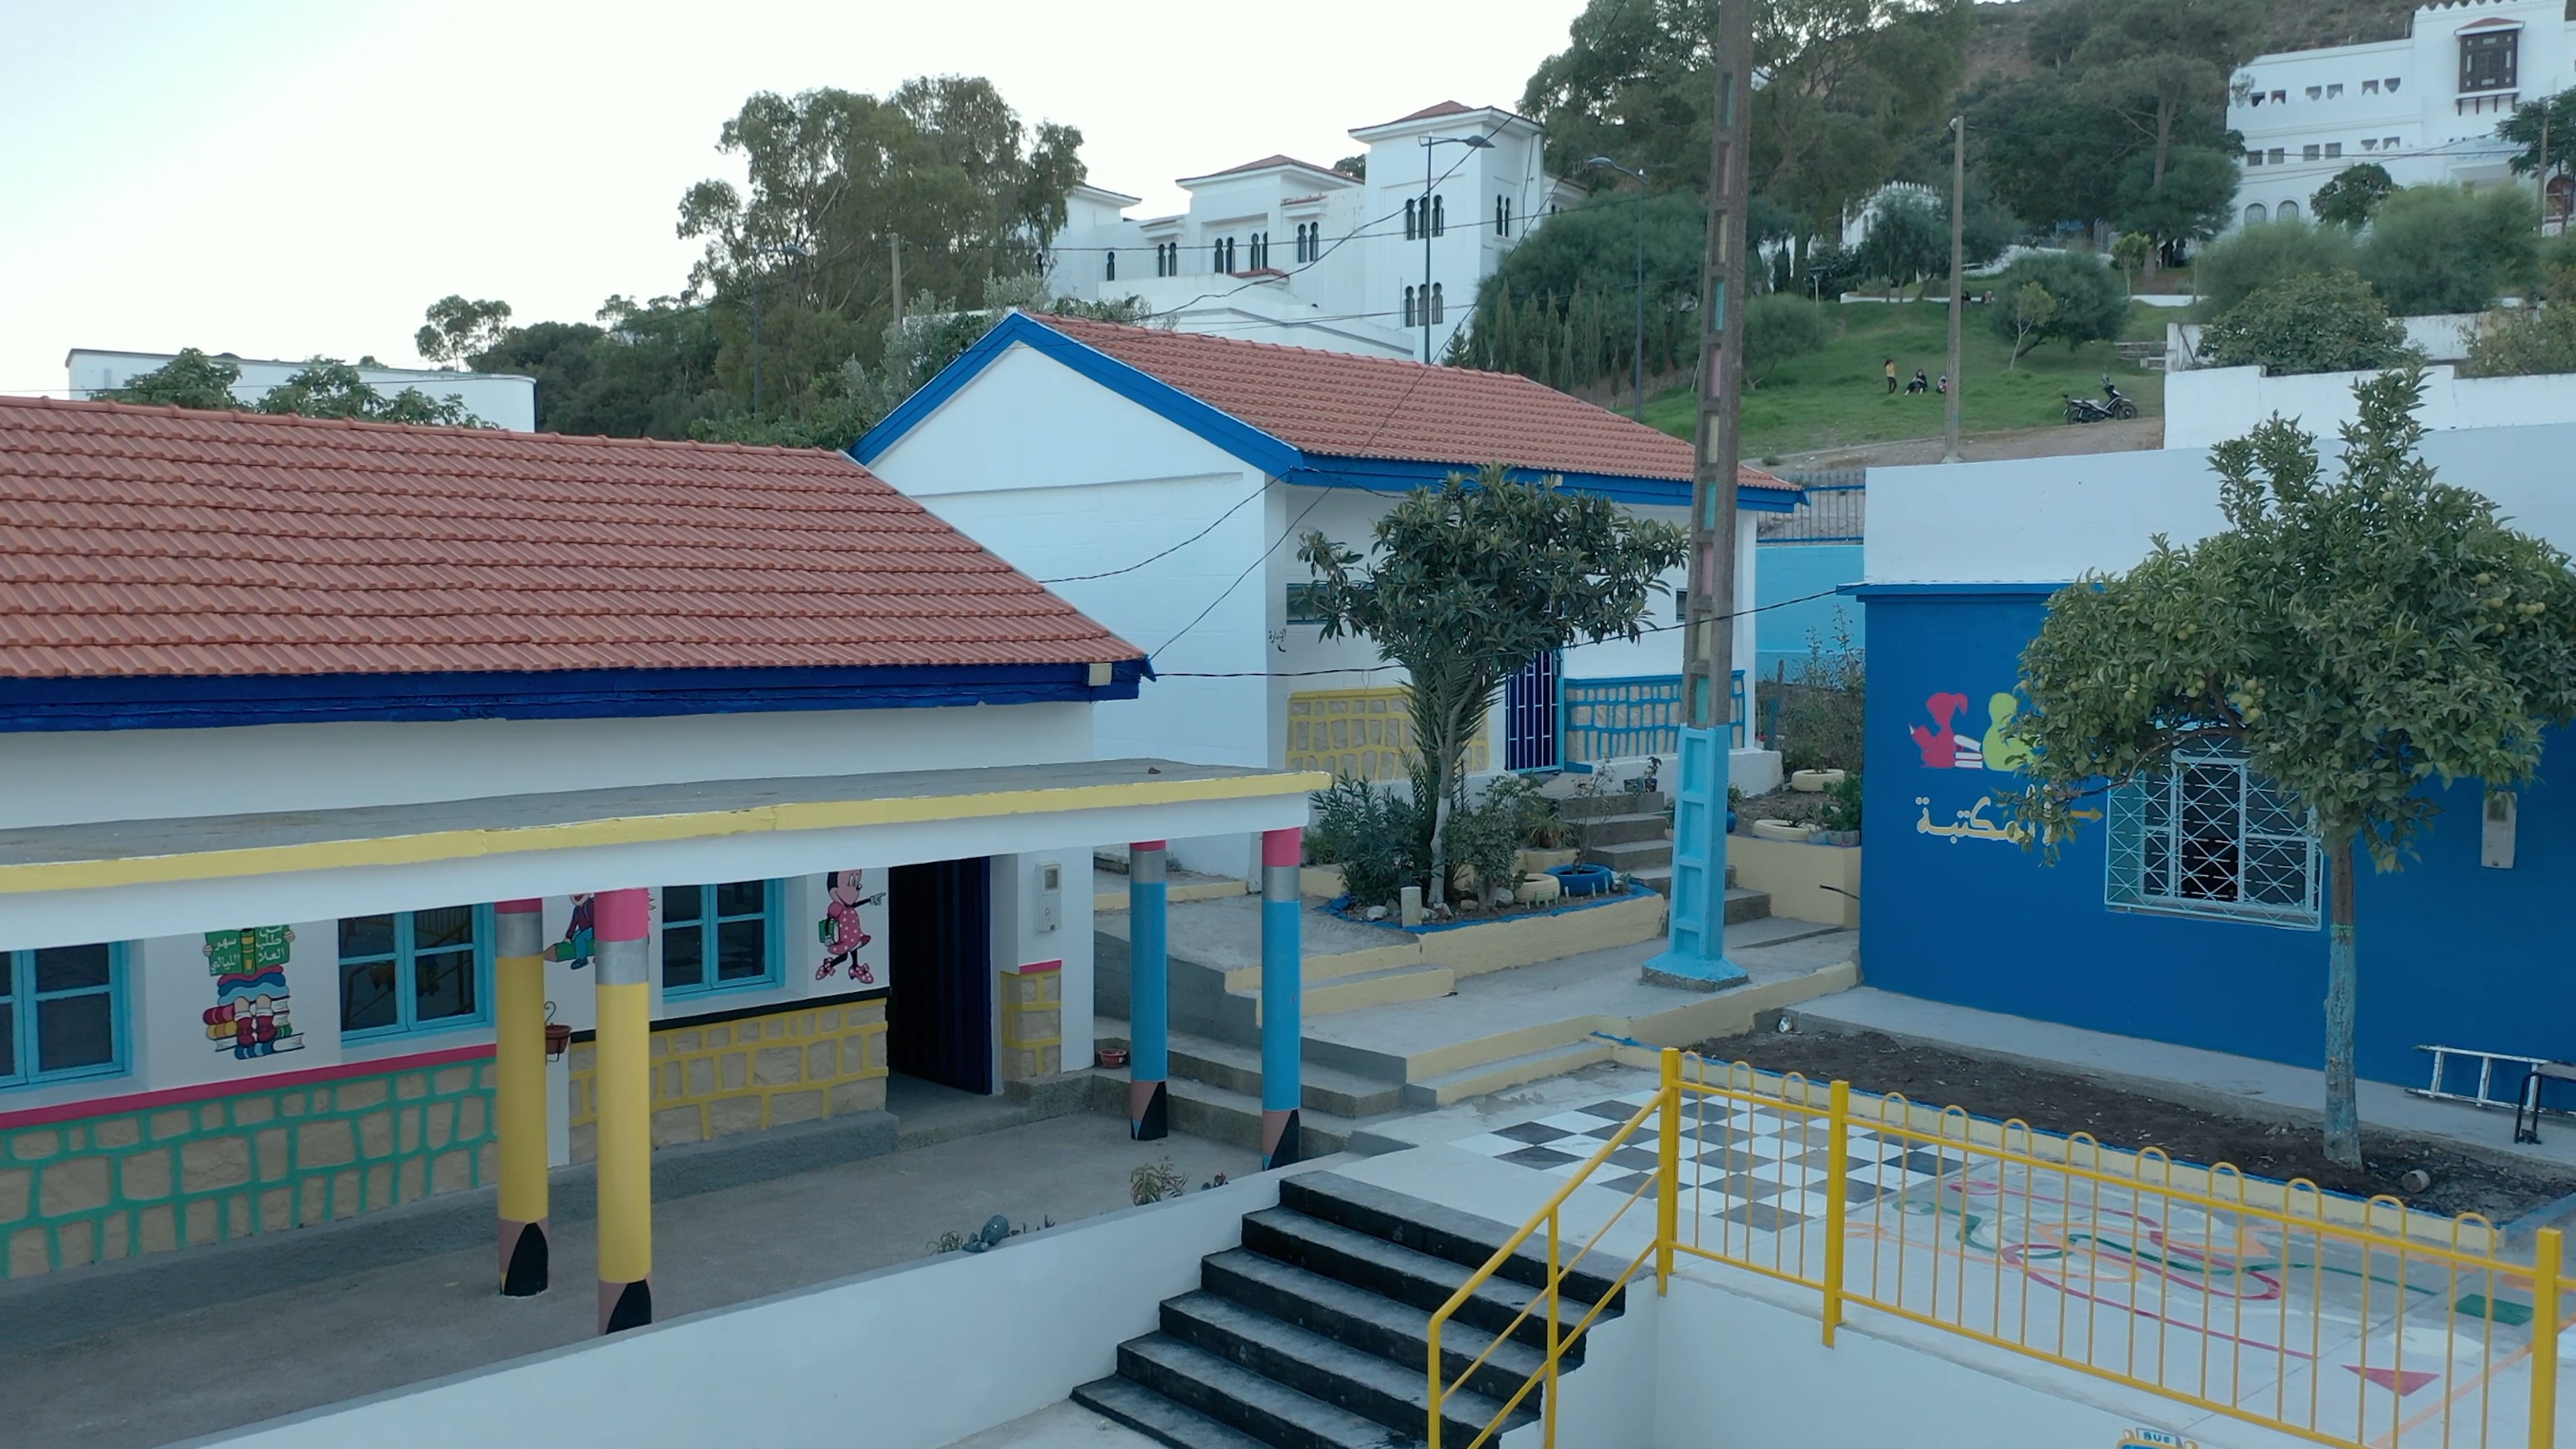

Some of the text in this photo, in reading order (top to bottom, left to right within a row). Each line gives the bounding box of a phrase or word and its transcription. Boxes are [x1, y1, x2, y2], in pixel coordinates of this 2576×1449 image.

[215, 938, 237, 951] سهر
[256, 934, 282, 949] طلب
[258, 949, 285, 962] العلا
[210, 954, 240, 973] الليالي
[2143, 1432, 2170, 1444] BUS
